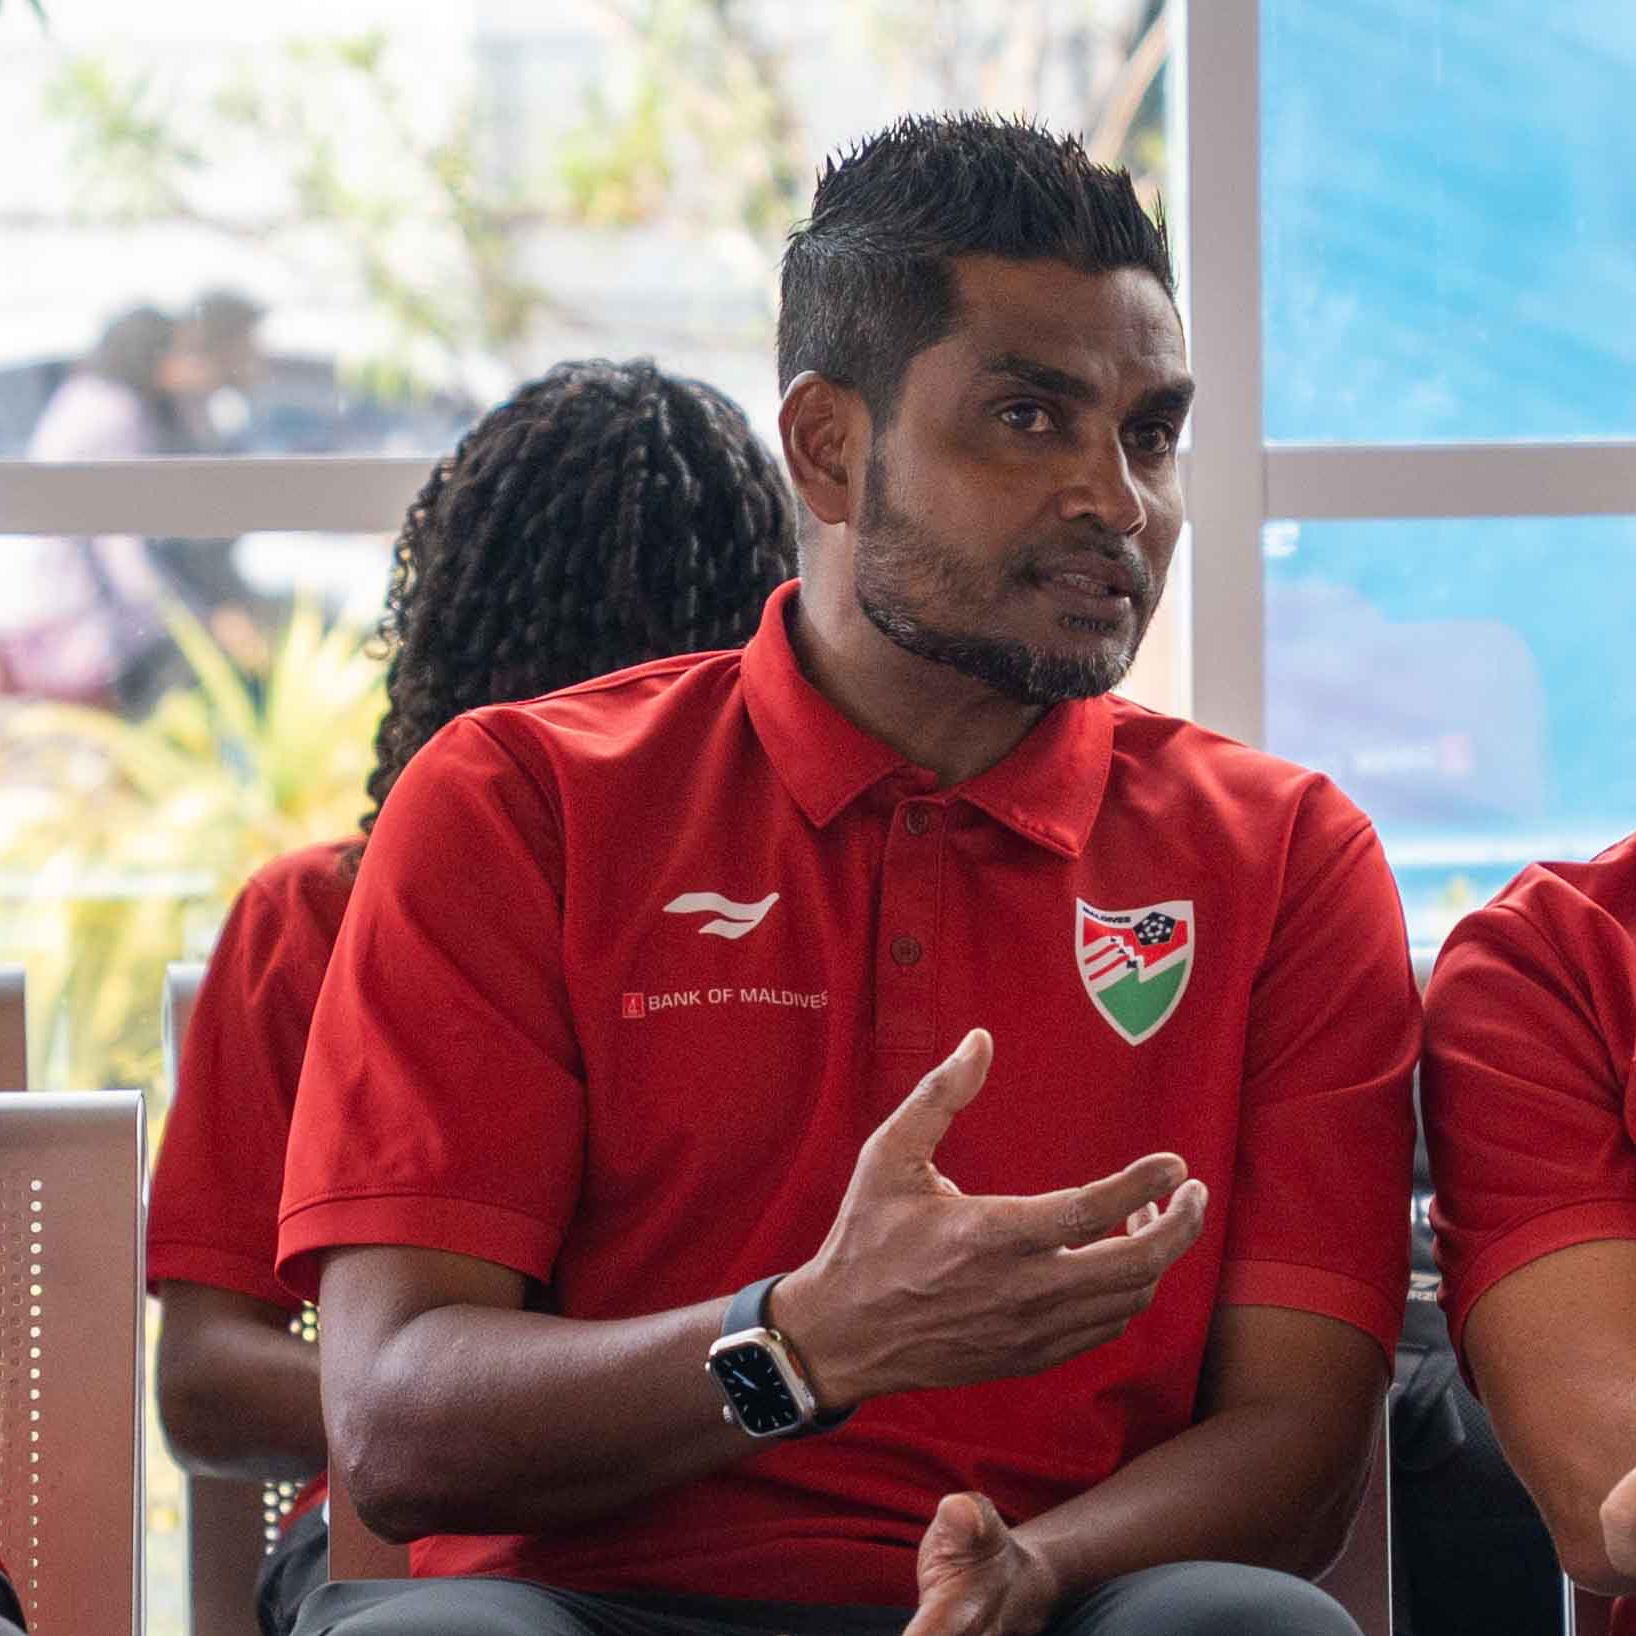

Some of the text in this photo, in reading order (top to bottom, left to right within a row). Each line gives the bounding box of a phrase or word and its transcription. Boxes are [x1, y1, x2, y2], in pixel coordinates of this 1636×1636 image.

[648, 988, 830, 1011] BANK OF MALDIVES
